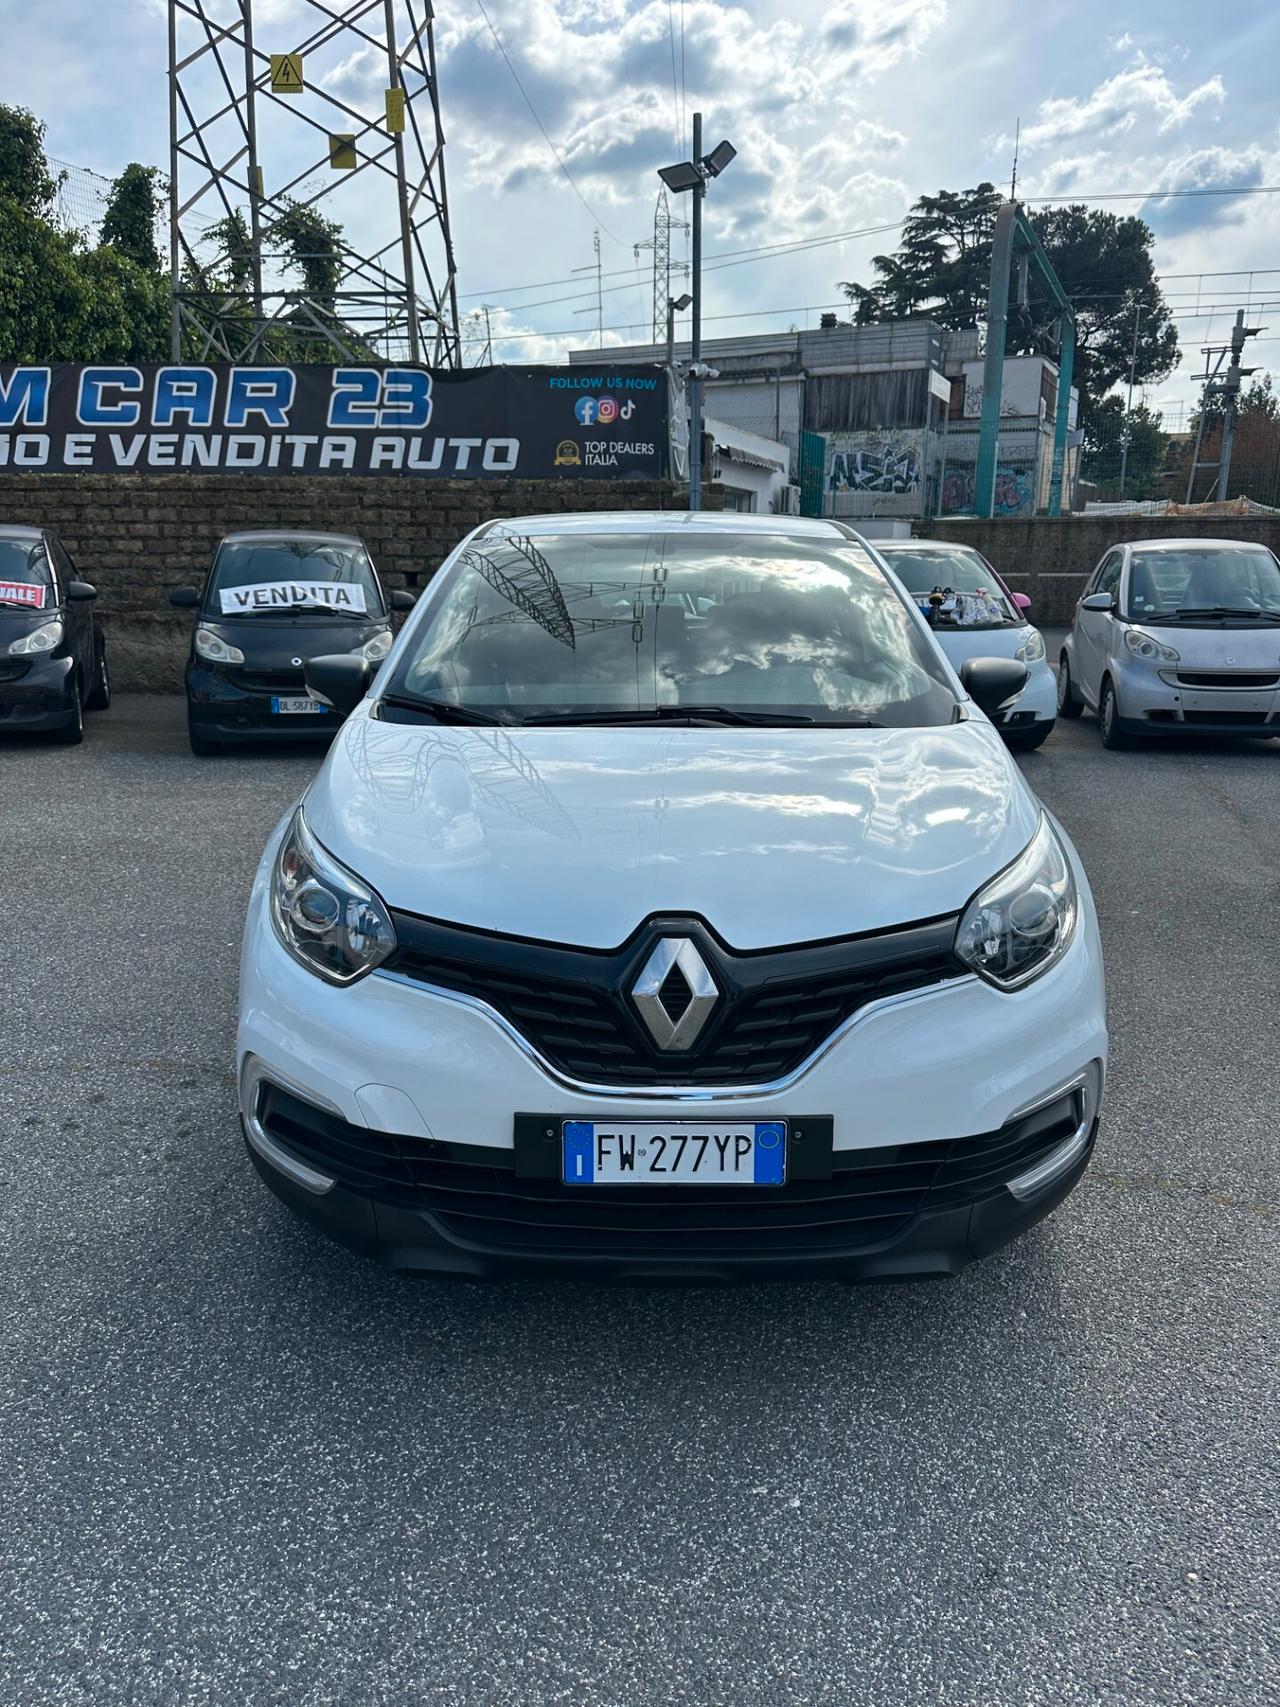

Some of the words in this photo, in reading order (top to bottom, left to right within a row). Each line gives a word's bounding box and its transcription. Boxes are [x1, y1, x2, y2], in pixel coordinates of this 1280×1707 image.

[550, 378, 603, 389] FOLLOW
[607, 377, 622, 388] US
[626, 378, 657, 390] NOW
[76, 366, 296, 427] CAR
[327, 368, 433, 429] 23
[64, 434, 96, 465] E
[109, 434, 357, 468] VENDITA
[370, 437, 520, 470] AUTO
[585, 441, 607, 453] TOP
[610, 441, 655, 455] DEALERS
[585, 454, 618, 466] ITALIA
[234, 585, 352, 606] VENDITA
